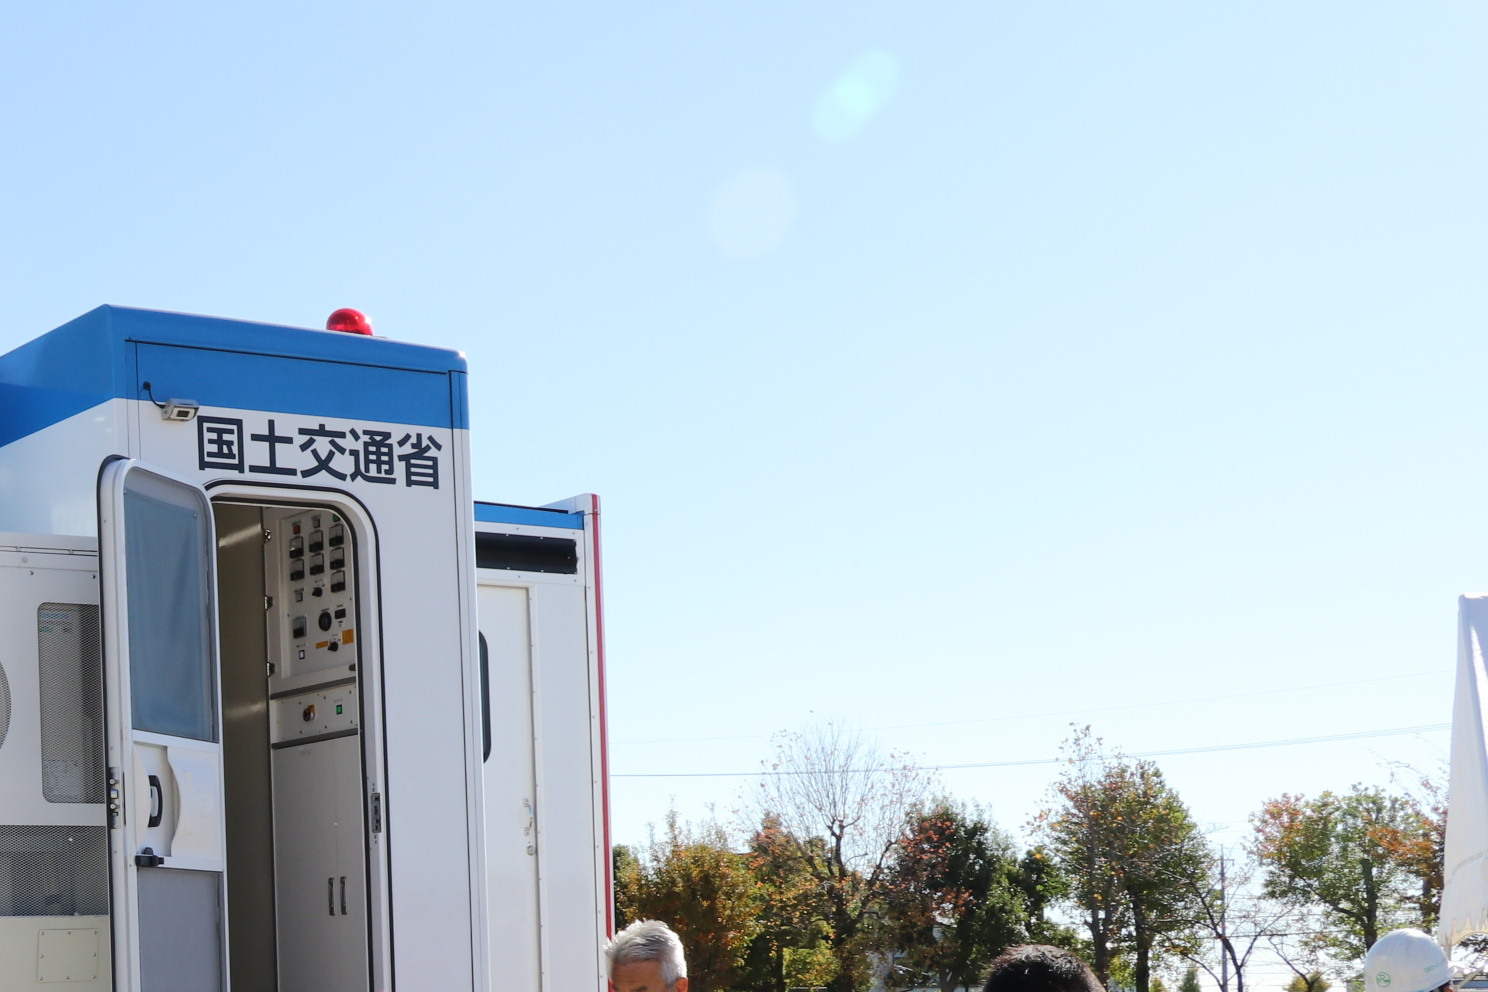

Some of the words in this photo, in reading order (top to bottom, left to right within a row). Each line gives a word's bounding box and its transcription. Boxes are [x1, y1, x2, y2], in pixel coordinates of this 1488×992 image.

[197, 415, 443, 490] 国土交通省
